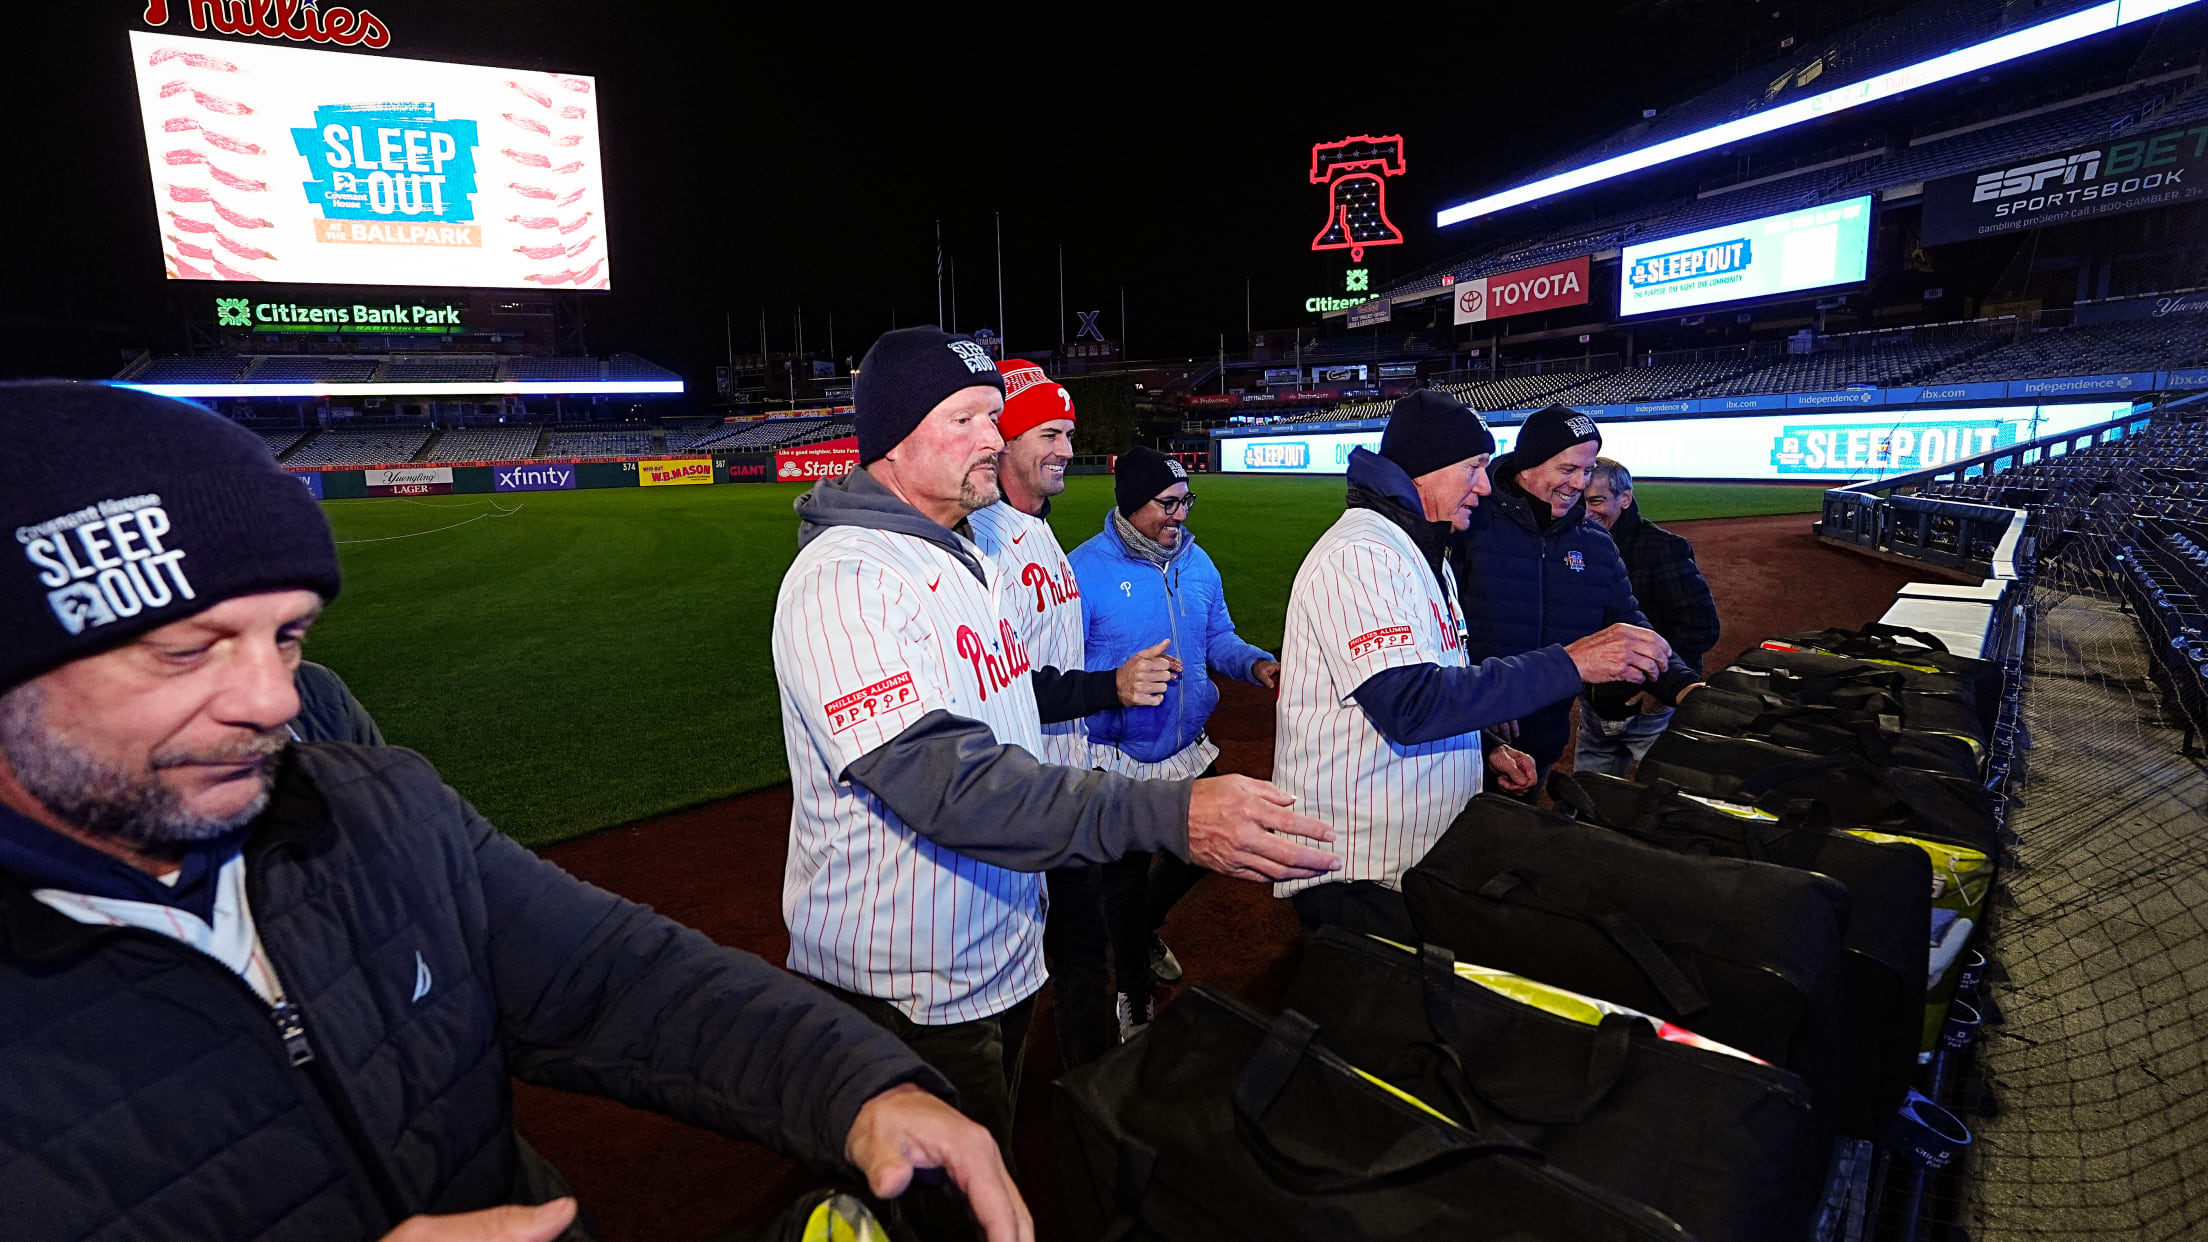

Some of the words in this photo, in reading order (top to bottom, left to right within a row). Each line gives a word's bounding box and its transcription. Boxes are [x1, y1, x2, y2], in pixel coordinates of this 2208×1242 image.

[323, 123, 456, 174] SLEEP
[1972, 150, 2102, 203] ESPN
[367, 170, 447, 216] OUT
[1994, 168, 2185, 218] SPORTSBOOK
[328, 223, 342, 231] AT
[1978, 218, 2022, 234] Gambling
[2071, 206, 2090, 218] Call
[326, 231, 346, 240] THE
[351, 223, 473, 245] BALLPARK
[1647, 250, 1704, 284] SLEEP
[1705, 242, 1743, 273] OUT
[1491, 271, 1580, 307] TOYOTA
[255, 303, 350, 323] Citizens
[353, 304, 410, 324] Bank
[412, 306, 460, 325] Park
[1922, 387, 1966, 400] ibx.com
[2025, 379, 2114, 394] Independence
[1635, 403, 1681, 414] Independence
[1726, 399, 1757, 409] ibx.com
[1798, 392, 1860, 405] Independence
[1254, 445, 1284, 466] SLEEP
[1284, 444, 1306, 466] OUT
[1805, 429, 1915, 470] SLEEP
[1919, 427, 1999, 470] OUT
[382, 470, 437, 484] Yuengling
[499, 466, 570, 488] xfinity
[622, 462, 636, 472] 374
[729, 465, 765, 476] GIANT
[393, 484, 429, 494] LAGER
[25, 506, 171, 588] SLEEP
[96, 549, 196, 618] OUT
[1380, 626, 1410, 636] ALUMNI
[827, 690, 868, 713] PHILLIES
[870, 672, 910, 695] ALUMNI
